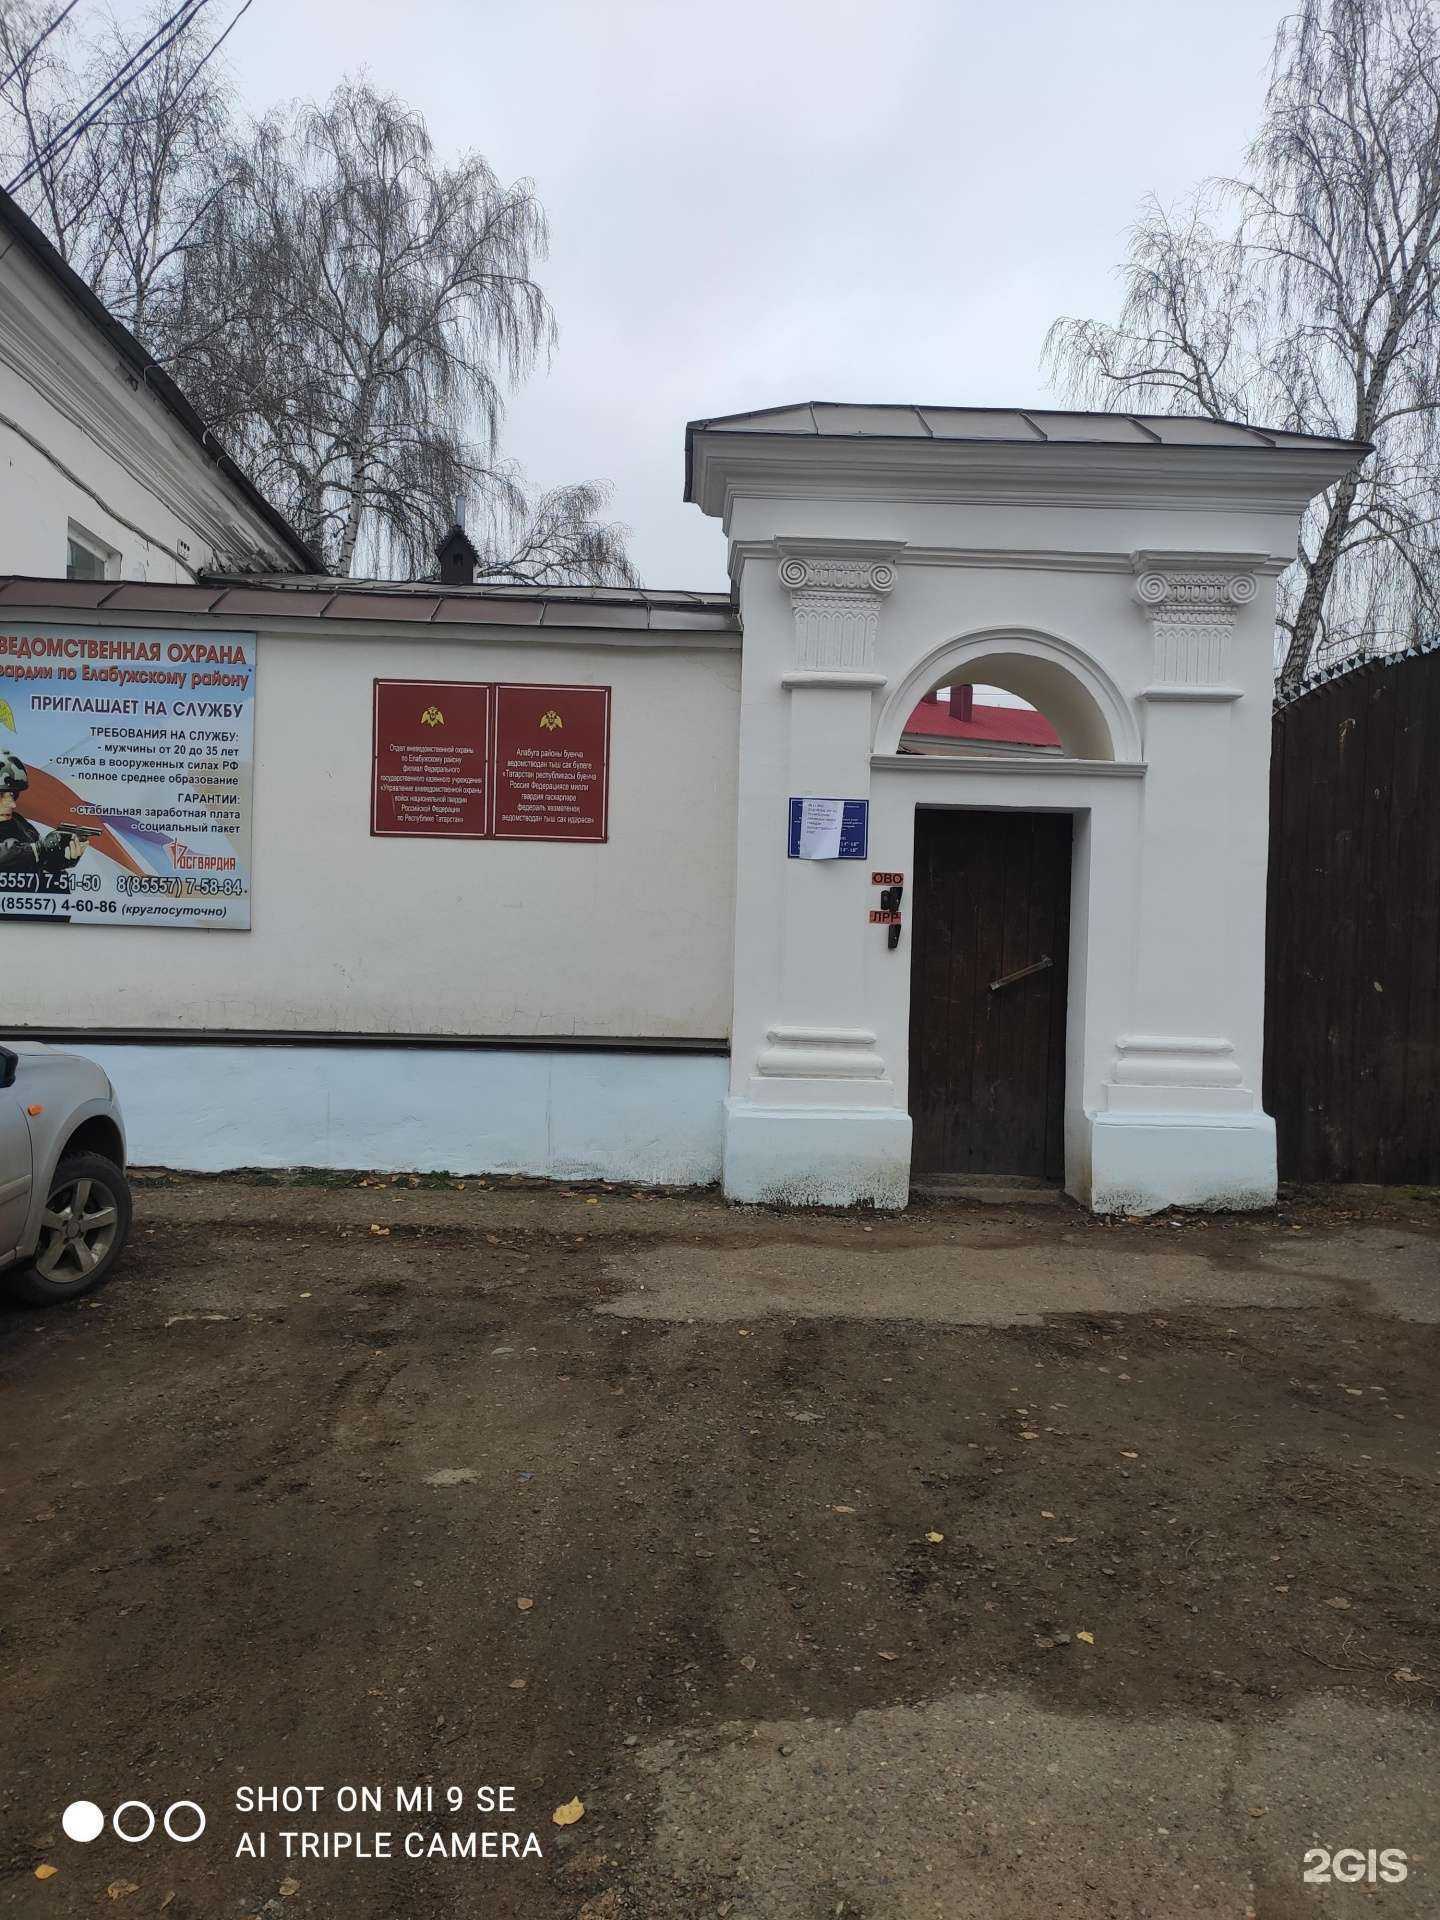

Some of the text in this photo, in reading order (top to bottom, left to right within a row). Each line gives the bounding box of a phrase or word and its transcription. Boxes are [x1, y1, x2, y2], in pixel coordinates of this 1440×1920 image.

[168, 643, 246, 664] ОХРАНА
[57, 666, 77, 681] по
[82, 664, 187, 688] Елабужскому
[191, 669, 249, 691] району
[31, 695, 243, 718] ПРИГЛАШАЕТ НА СЛУЖБУ
[90, 727, 239, 742] ТРЕБОВАНИЯ НА СЛУЖБУ:
[105, 745, 156, 755] мужчины
[159, 746, 170, 754] от
[174, 744, 186, 755] 20
[189, 747, 203, 757] до
[206, 746, 217, 756] 35
[220, 748, 239, 756] лет
[56, 756, 96, 767] служба
[99, 758, 106, 766] в
[109, 758, 184, 769] вооруженных
[187, 762, 218, 770] силах
[222, 761, 239, 771] РФ
[78, 772, 117, 781] полное
[121, 774, 165, 783] среднее
[169, 774, 239, 785] образование
[178, 794, 240, 804] ГАРАНТИИ:
[78, 805, 141, 816] стабильная
[144, 807, 206, 819] заработная
[210, 810, 240, 819] плата
[139, 821, 207, 833] социальный
[211, 825, 240, 833] пакет
[45, 873, 101, 891] 7-51-50
[873, 872, 902, 884] ОВО
[117, 876, 182, 897] 8(85557)
[2, 897, 227, 918] (85557) 4-60-86 (круглосуточно)
